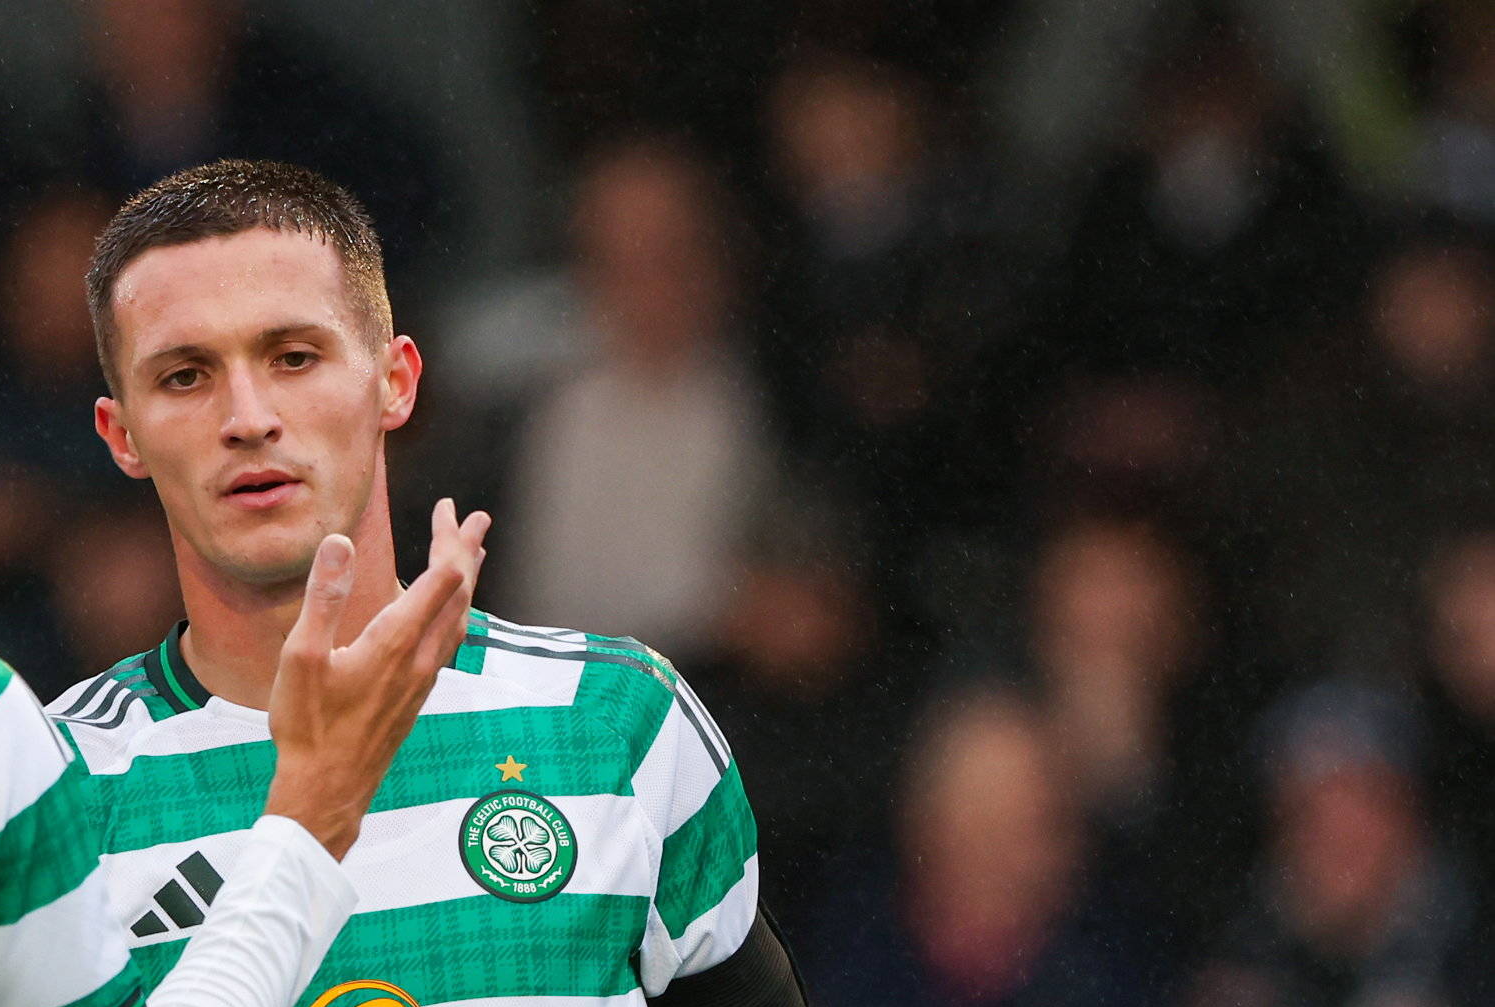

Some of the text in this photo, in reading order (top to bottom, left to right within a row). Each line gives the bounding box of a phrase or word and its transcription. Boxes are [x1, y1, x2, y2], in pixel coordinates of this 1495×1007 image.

[467, 796, 570, 847] THE CELTIC FOOTBALL CLUB
[512, 882, 537, 893] 1888
